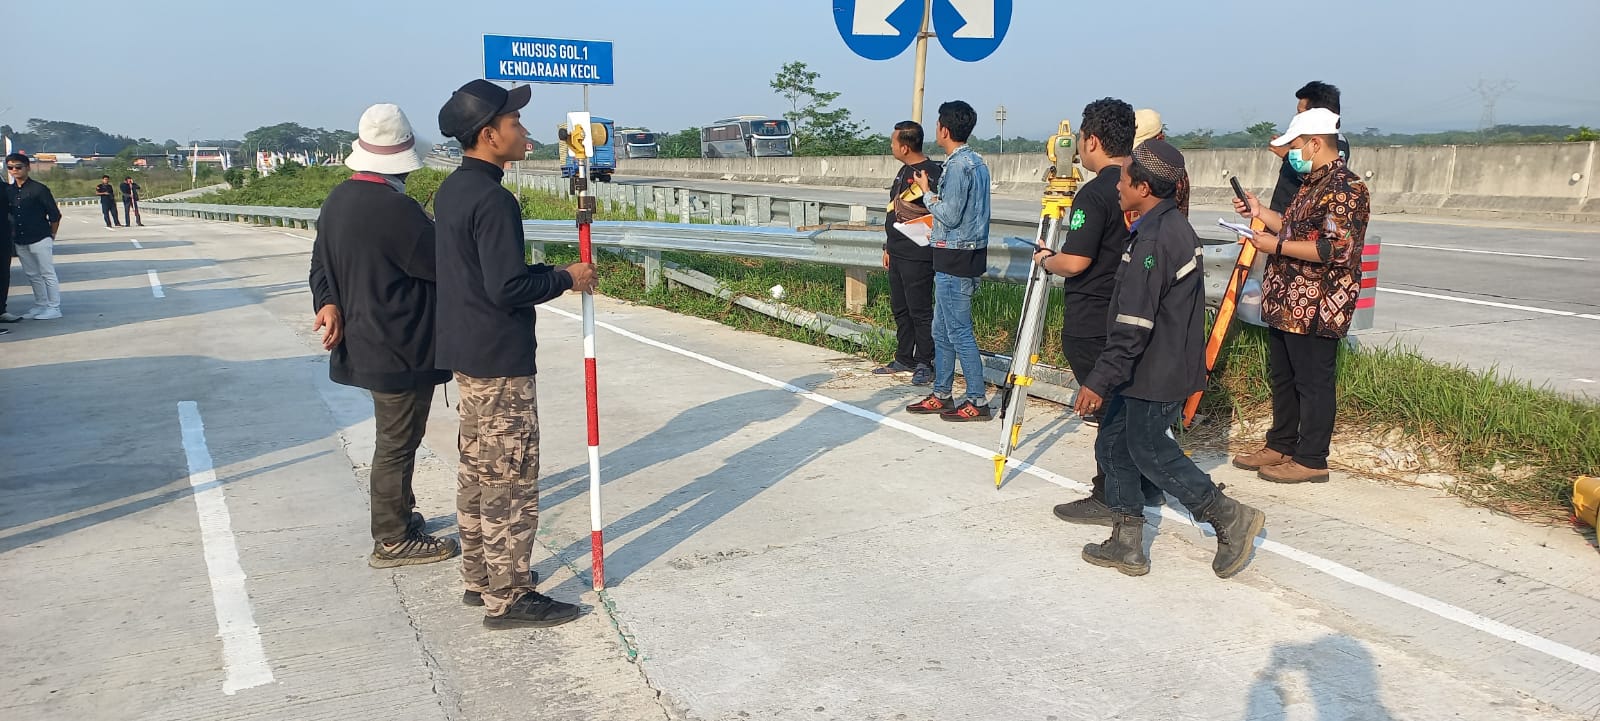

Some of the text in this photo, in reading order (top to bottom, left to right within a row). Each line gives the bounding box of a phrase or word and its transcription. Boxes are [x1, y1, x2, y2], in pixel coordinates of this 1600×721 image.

[511, 41, 588, 60] KHUSUS GOL.1
[499, 60, 601, 79] KENDARAAN KECIL
